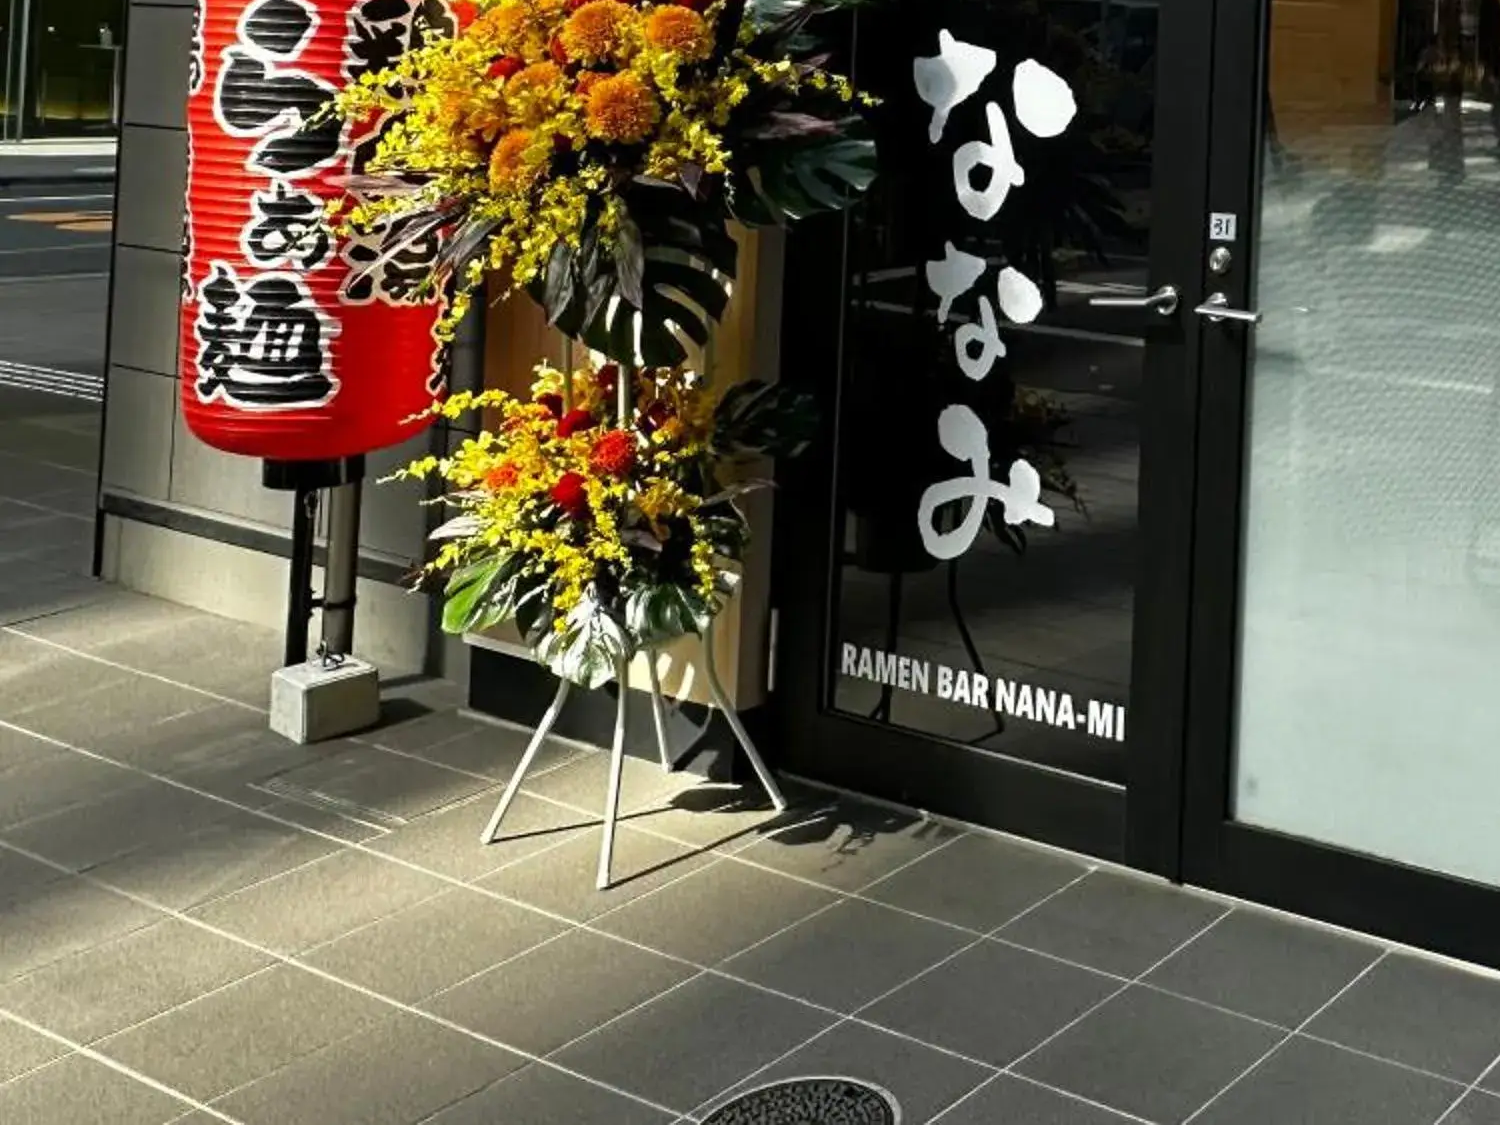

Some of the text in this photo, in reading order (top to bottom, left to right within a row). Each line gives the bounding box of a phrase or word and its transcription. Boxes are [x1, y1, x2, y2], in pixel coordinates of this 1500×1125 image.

[914, 28, 1078, 560] ななみ
[841, 642, 1125, 742] RAMEN BAR NANA-MI
